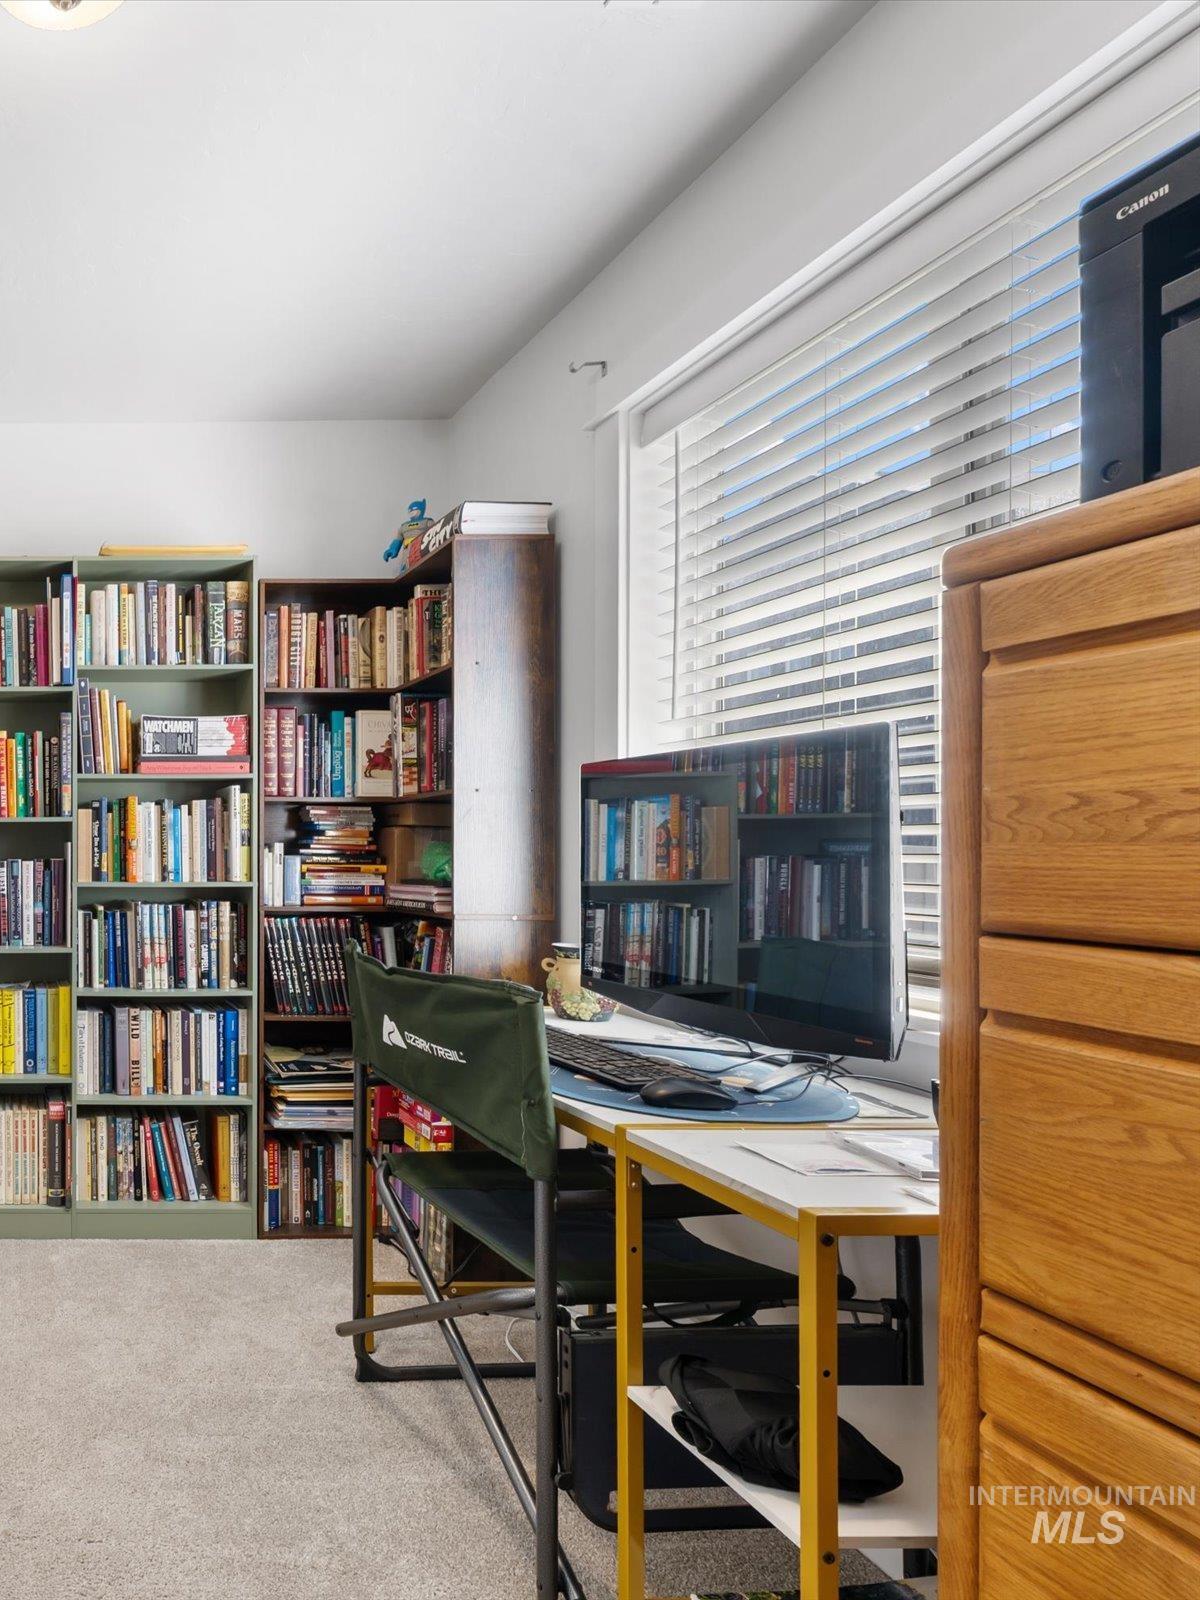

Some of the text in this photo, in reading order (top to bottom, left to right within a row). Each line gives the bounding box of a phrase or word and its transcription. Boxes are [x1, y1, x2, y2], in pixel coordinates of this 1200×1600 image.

[1115, 182, 1170, 221] Canon
[429, 521, 453, 553] CITY
[210, 600, 225, 648] TARZAN
[233, 609, 243, 639] MARS
[290, 613, 302, 667] DODGE CITY
[143, 720, 193, 733] WATCHMEN
[297, 941, 307, 973] DOCTOR
[132, 1015, 140, 1040] WILD
[189, 1126, 204, 1166] The Occult
